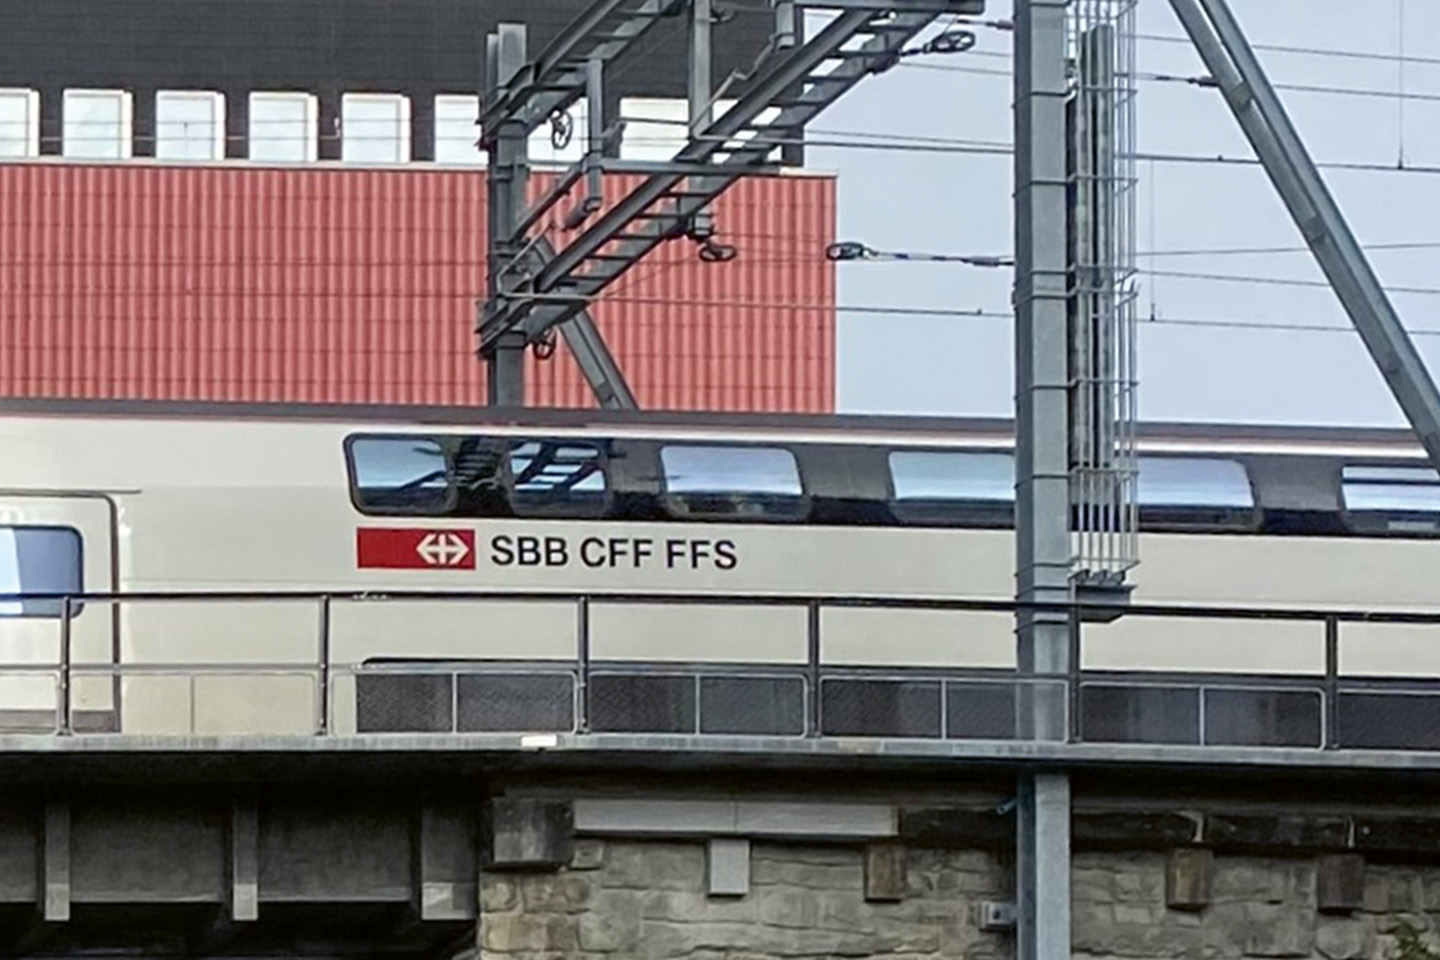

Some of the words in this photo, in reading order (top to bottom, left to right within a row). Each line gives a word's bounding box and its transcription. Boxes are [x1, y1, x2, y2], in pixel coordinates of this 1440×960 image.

[491, 535, 569, 567] SBB
[580, 537, 653, 568] CFF
[666, 540, 738, 570] FFS
